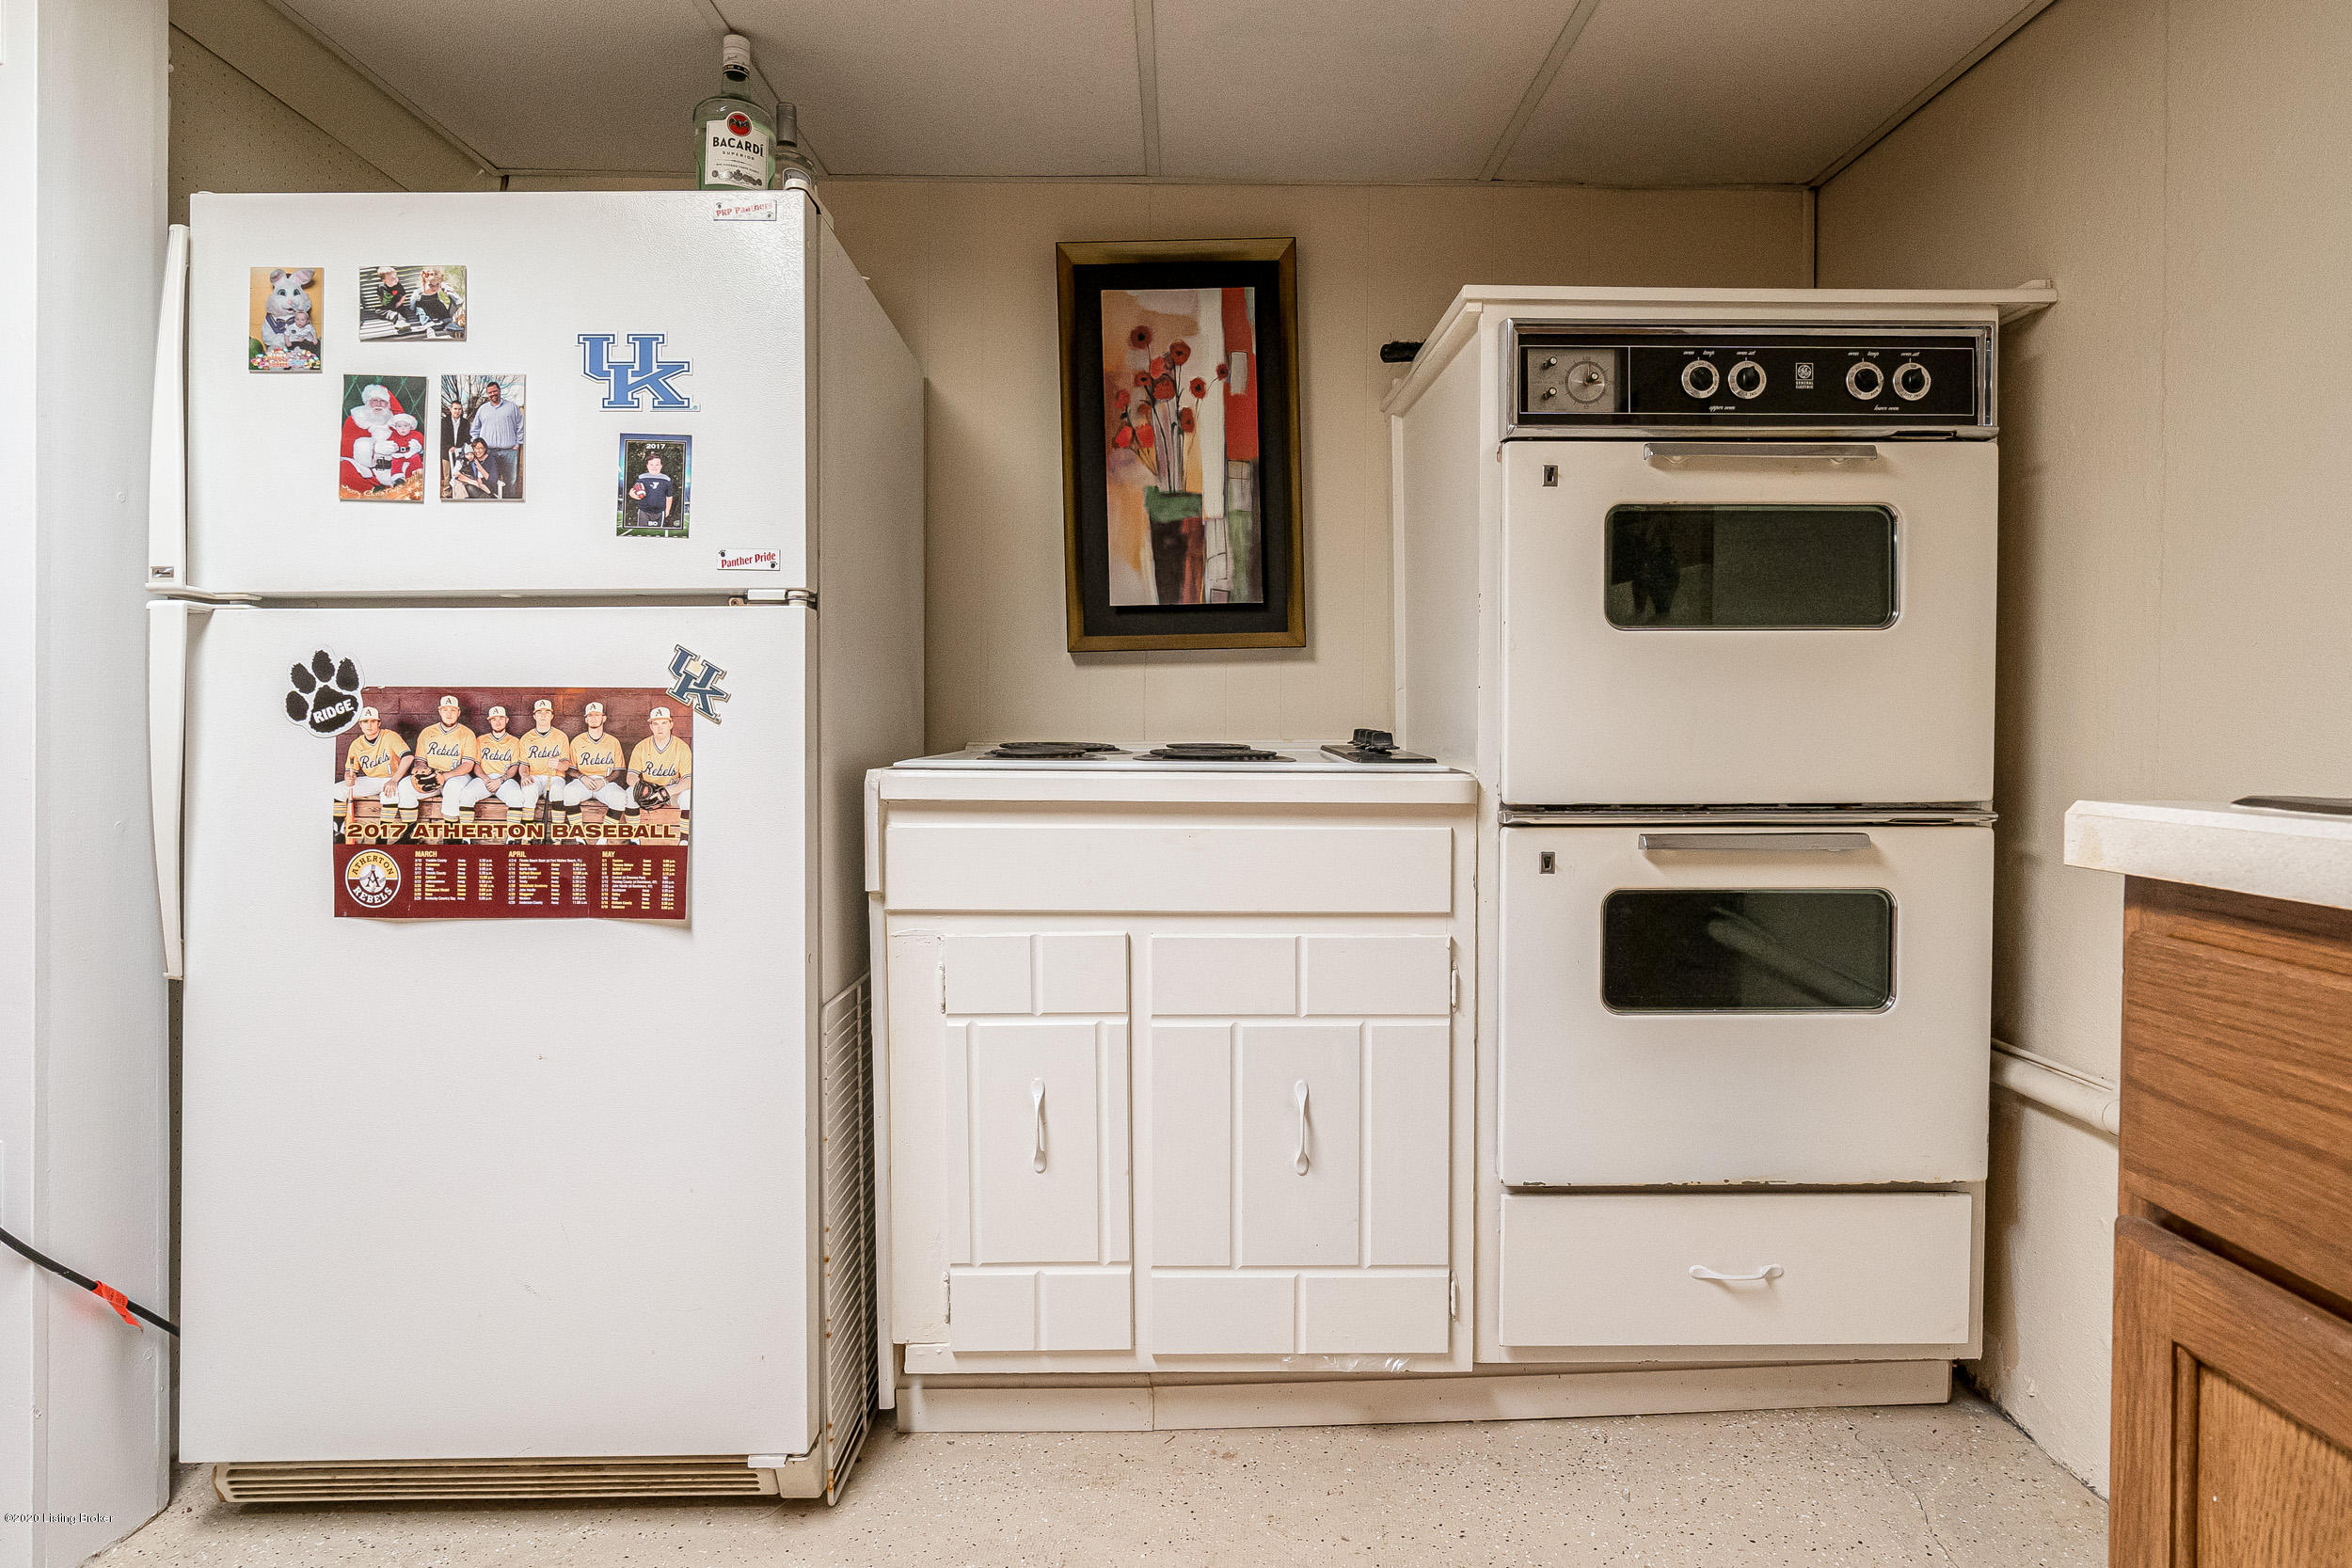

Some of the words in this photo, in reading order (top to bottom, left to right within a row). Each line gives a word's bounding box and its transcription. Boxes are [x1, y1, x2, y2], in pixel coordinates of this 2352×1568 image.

[713, 137, 764, 157] BACARDÍ
[723, 150, 755, 161] SUPERIOR
[578, 334, 690, 408] UK
[721, 556, 753, 568] Panther
[755, 551, 776, 563] Pride
[312, 699, 354, 723] RIDGE
[426, 741, 460, 757] Rebels
[528, 745, 561, 759] Rebels
[359, 749, 390, 769] Rebels
[579, 752, 614, 766] Rebels
[642, 760, 677, 777] Rebels
[345, 823, 408, 840] 2017
[411, 823, 546, 840] ATHERTON
[551, 823, 676, 840] BASEBALL
[351, 855, 394, 875] ATHERTON
[365, 870, 381, 887] A
[352, 886, 393, 903] REBELS
